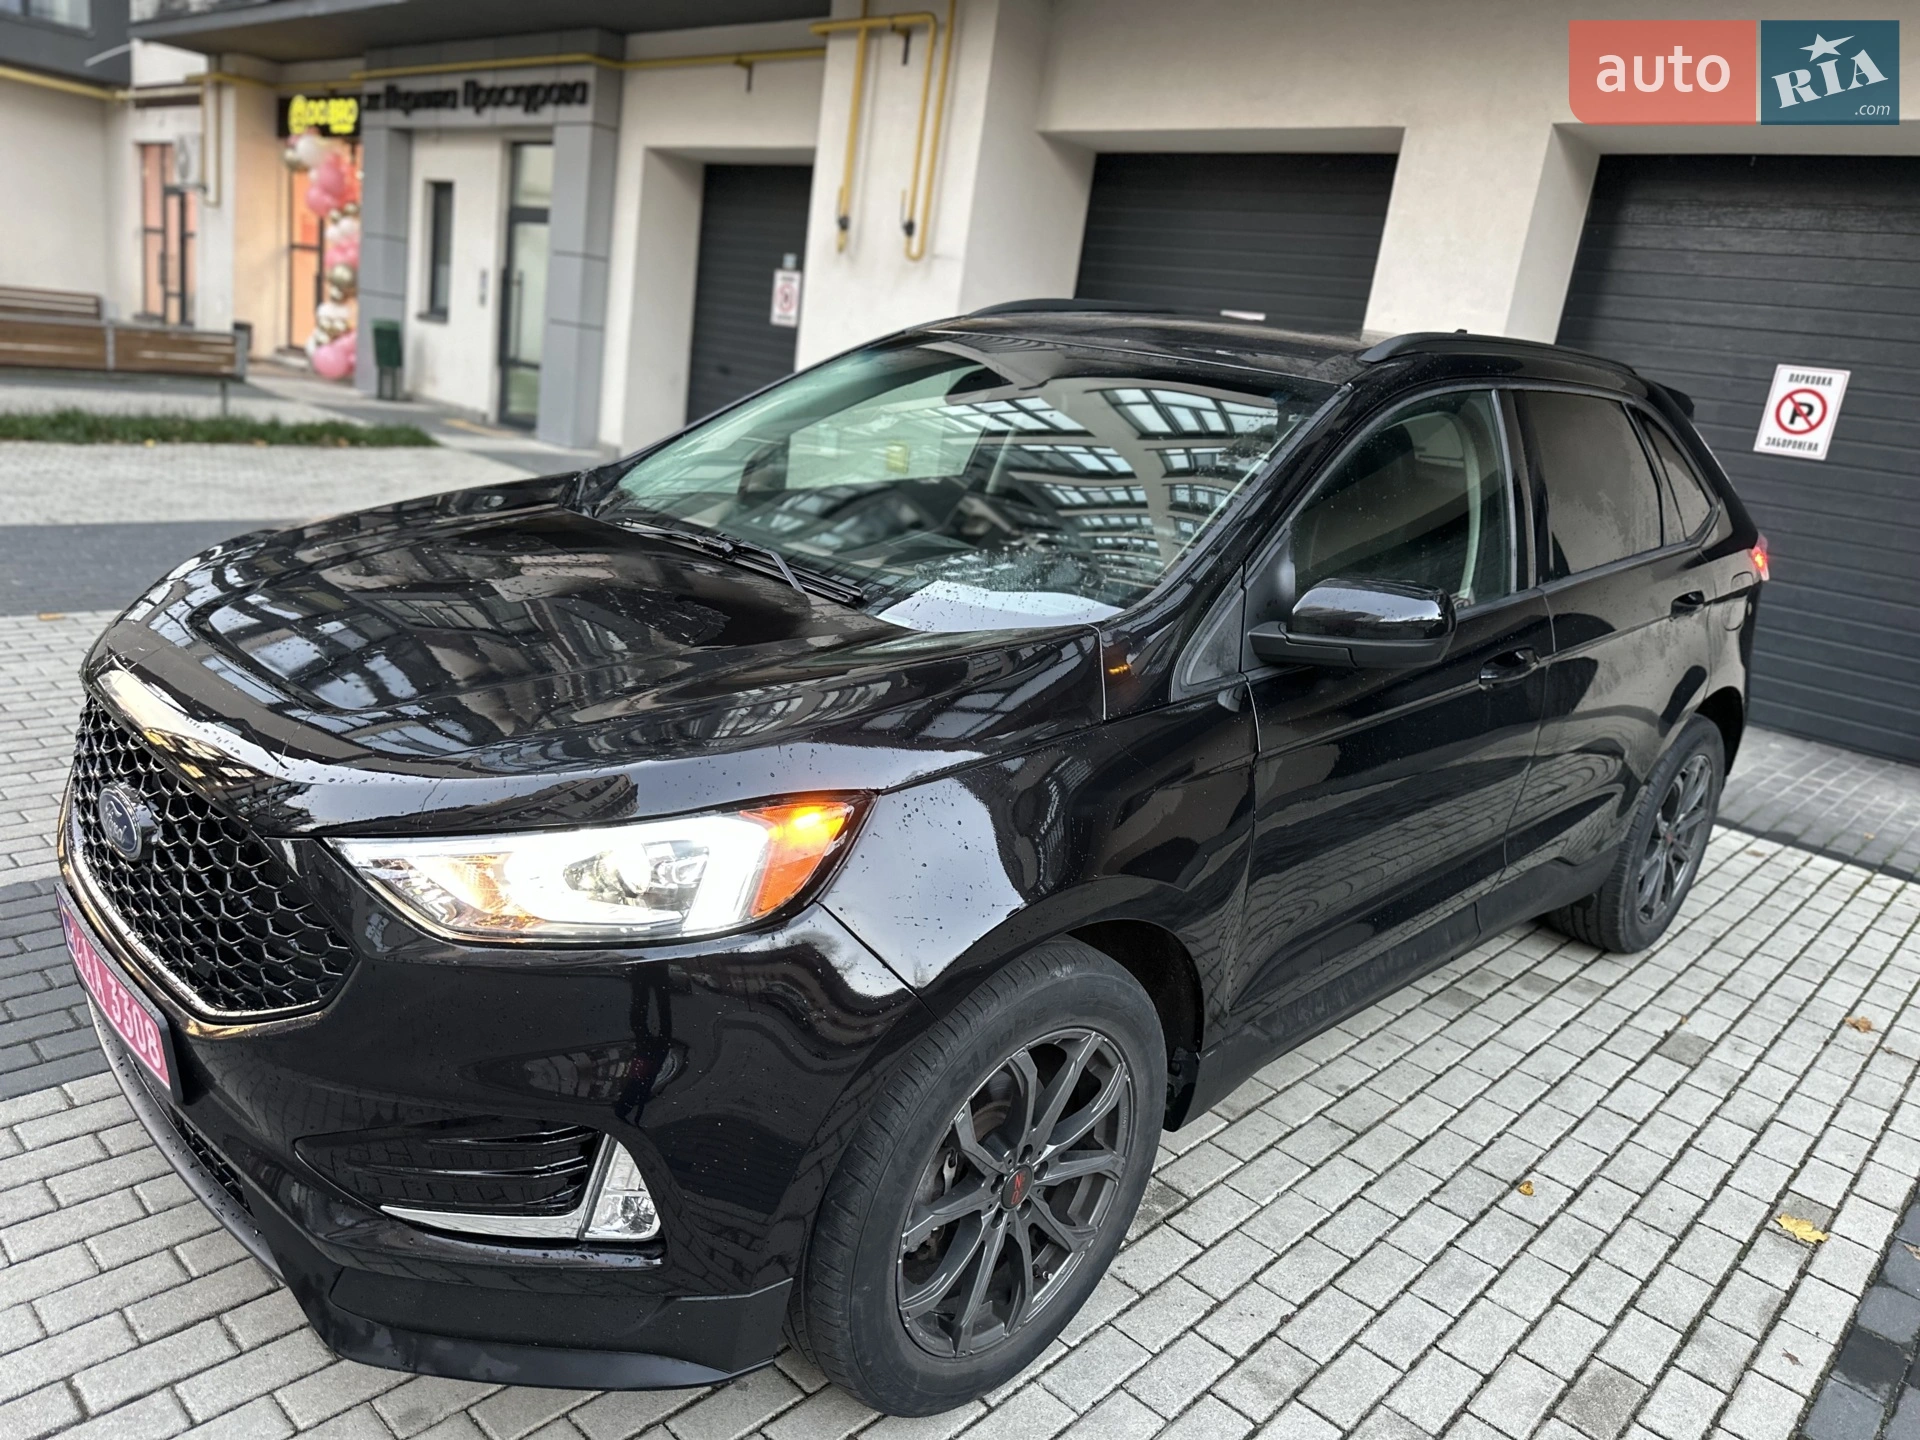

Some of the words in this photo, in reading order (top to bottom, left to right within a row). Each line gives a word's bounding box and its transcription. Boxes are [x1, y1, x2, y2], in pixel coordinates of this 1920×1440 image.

[1788, 373, 1833, 387] ПАРКОВКА
[1765, 436, 1819, 452] ЗАБОРОНЕНА
[107, 971, 162, 1070] 3308
